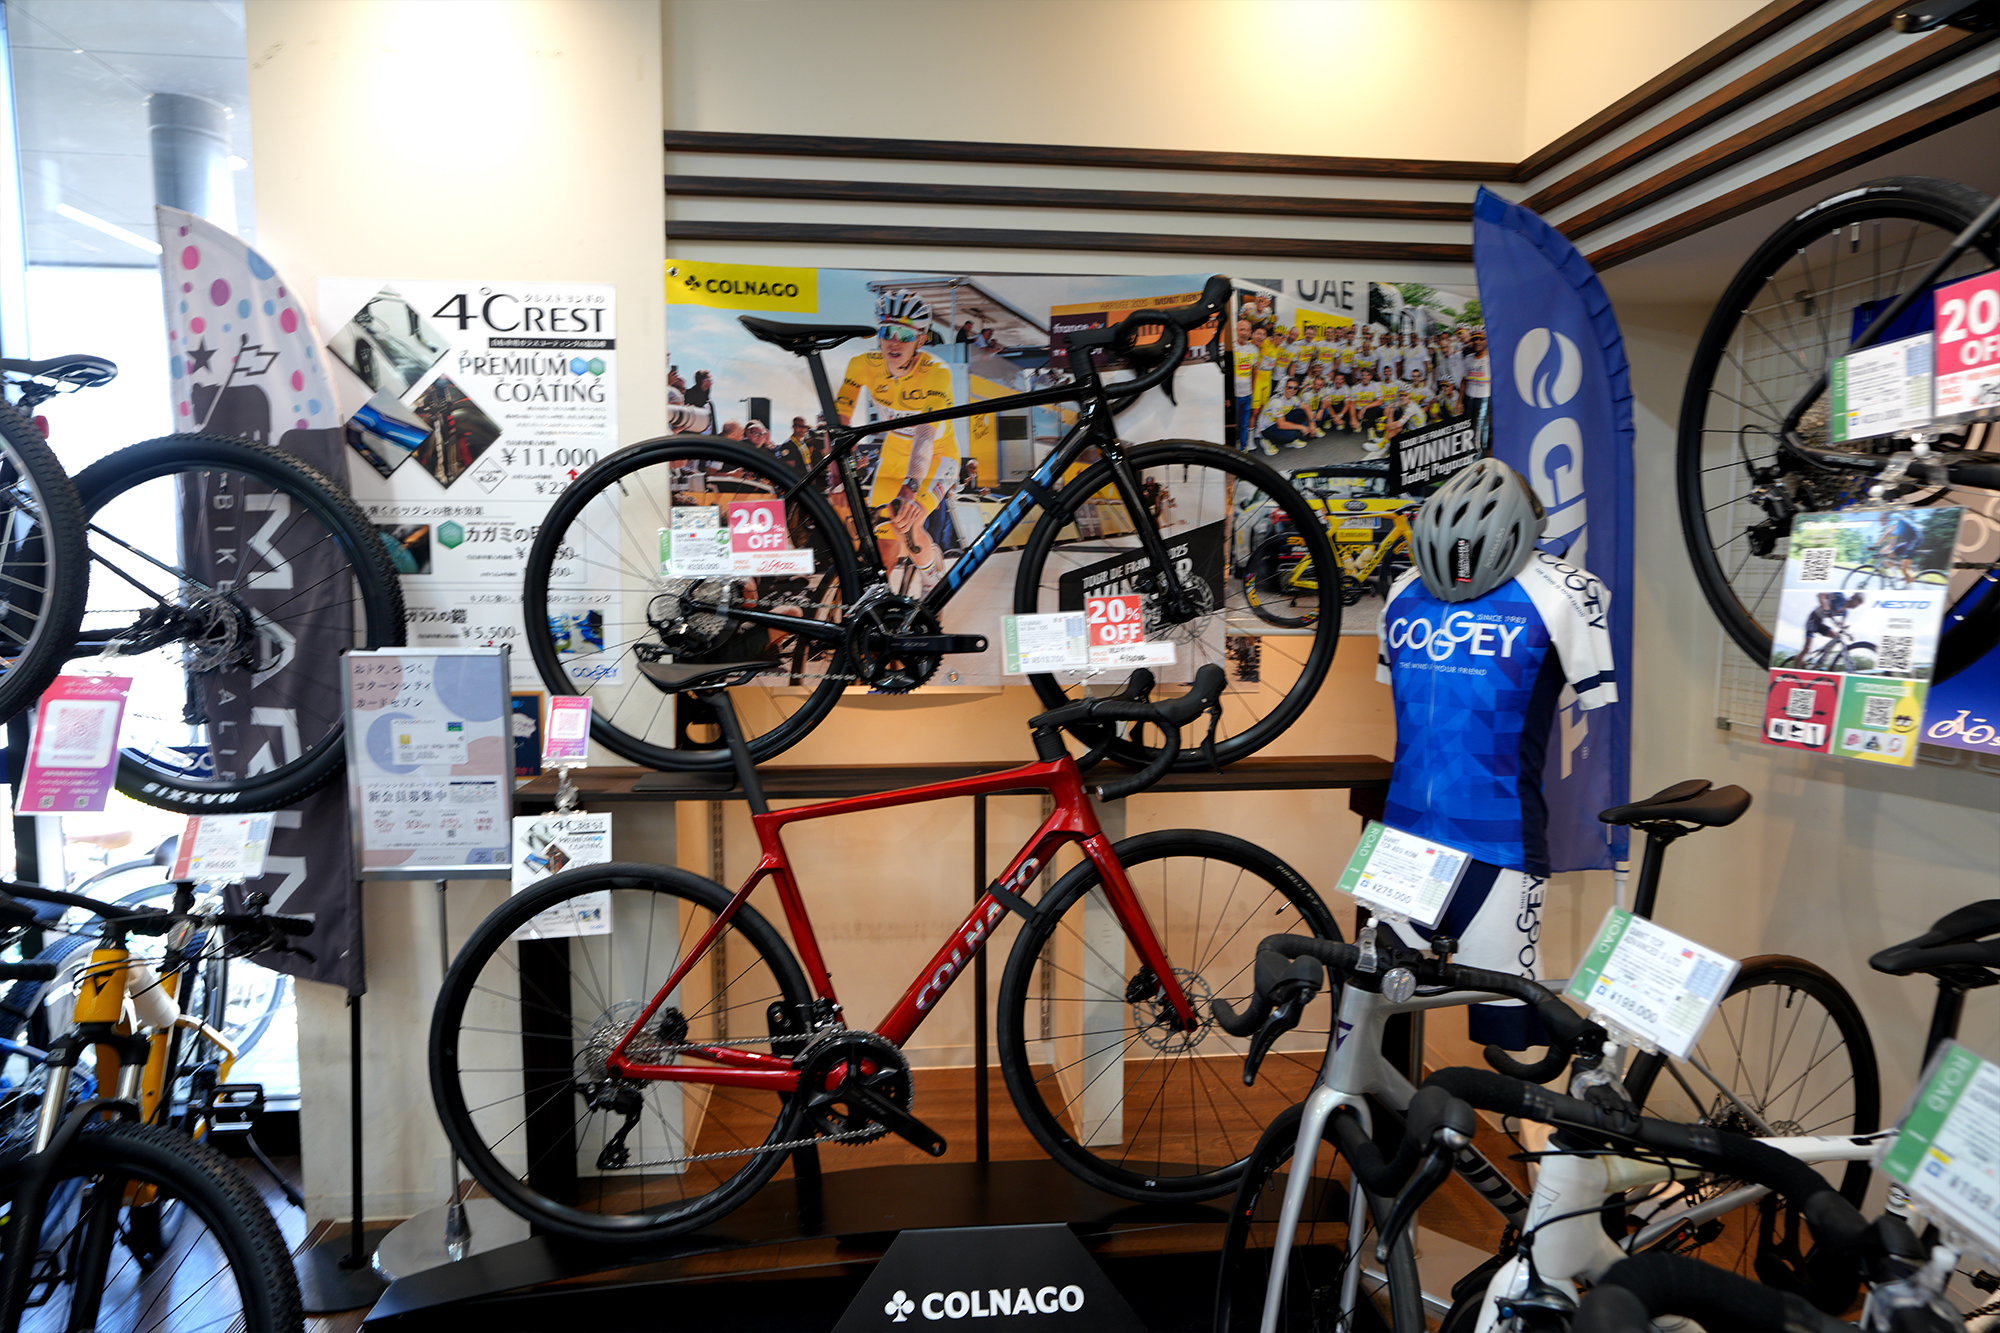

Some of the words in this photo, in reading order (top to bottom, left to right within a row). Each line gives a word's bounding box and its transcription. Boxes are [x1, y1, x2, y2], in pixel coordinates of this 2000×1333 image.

[706, 278, 799, 298] COLNAGO
[1297, 280, 1354, 311] UAE
[1938, 288, 2000, 345] 20
[1959, 330, 2000, 366] OF
[459, 357, 567, 376] PREMIUM
[494, 383, 606, 403] COATING
[1400, 429, 1475, 472] WINNER
[747, 533, 783, 550] OFF
[1125, 556, 1151, 576] FRAN
[1089, 598, 1140, 624] 20%
[1476, 613, 1503, 622] SINCE
[1871, 600, 1932, 610] NESTO
[1100, 623, 1141, 642] OFF
[1389, 610, 1524, 662] COGGEY
[141, 782, 241, 805] MAXXIS
[1358, 826, 1381, 858] ROAD
[1598, 914, 1628, 954] ROAD
[1926, 1054, 1974, 1113] ROAD
[920, 1283, 1085, 1321] COLNAGO
